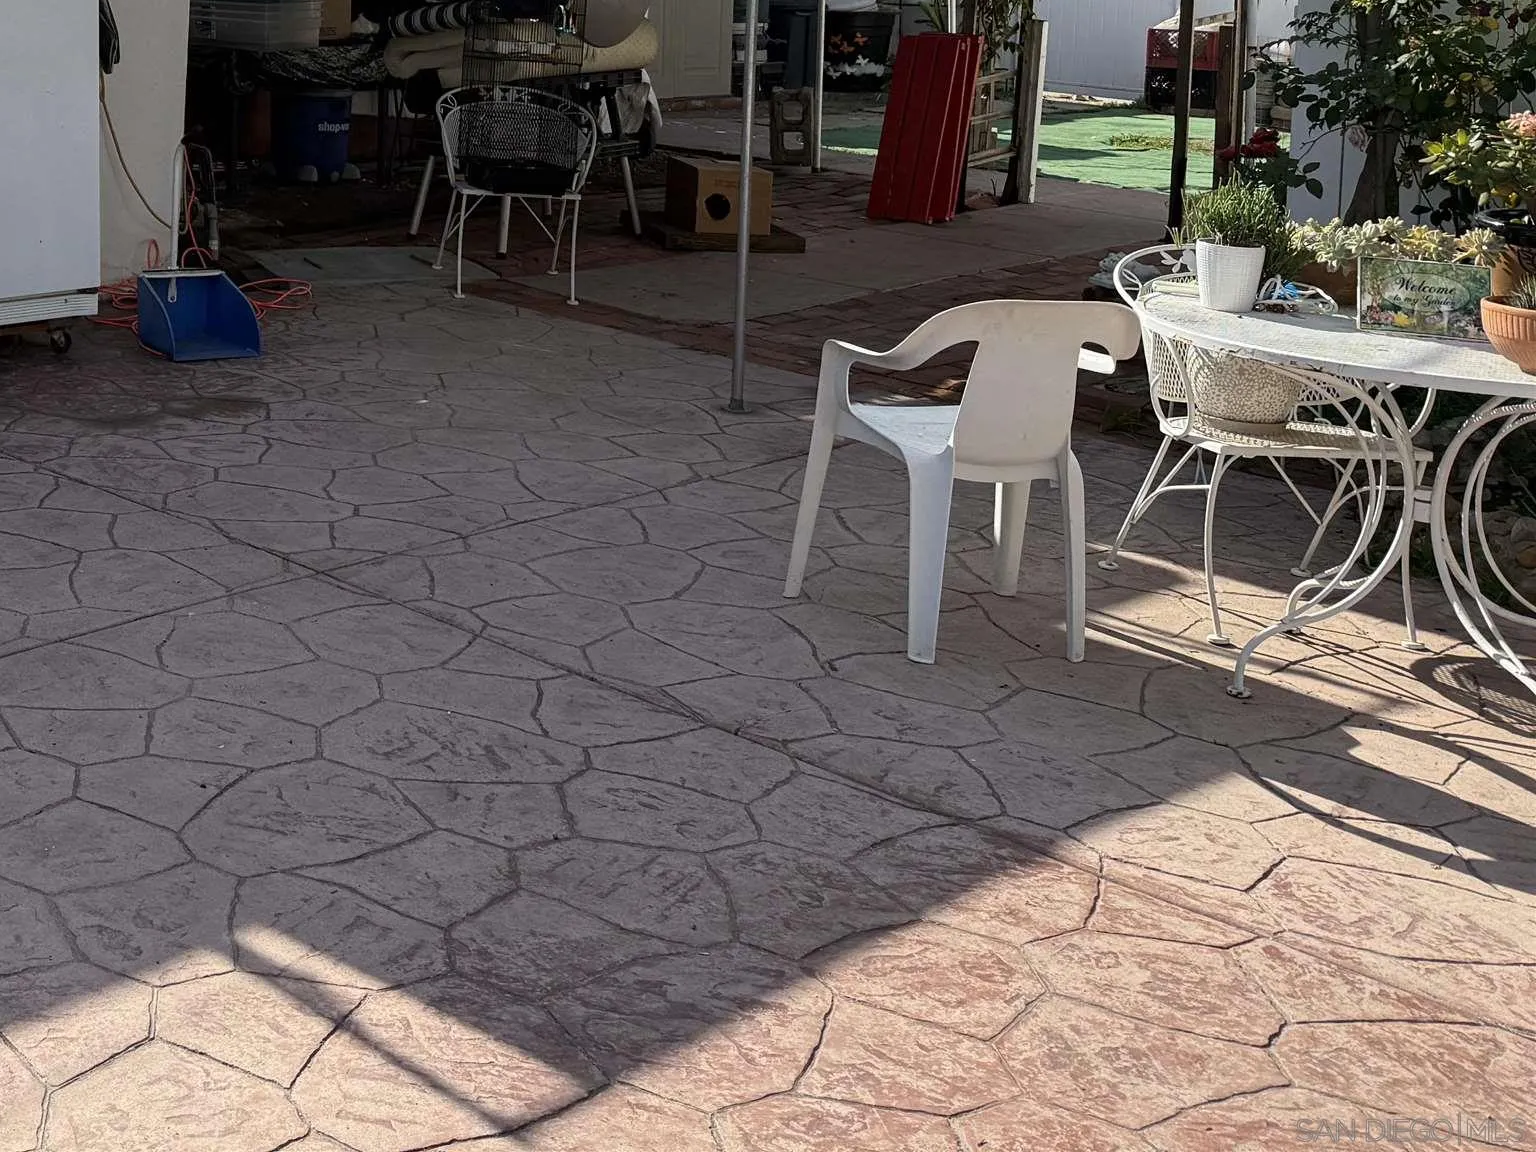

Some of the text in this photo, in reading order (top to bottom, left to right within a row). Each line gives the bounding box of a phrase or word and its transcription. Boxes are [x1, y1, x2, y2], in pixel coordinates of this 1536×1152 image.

[1395, 276, 1457, 294] Welcome
[1392, 294, 1457, 306] to my Garden
